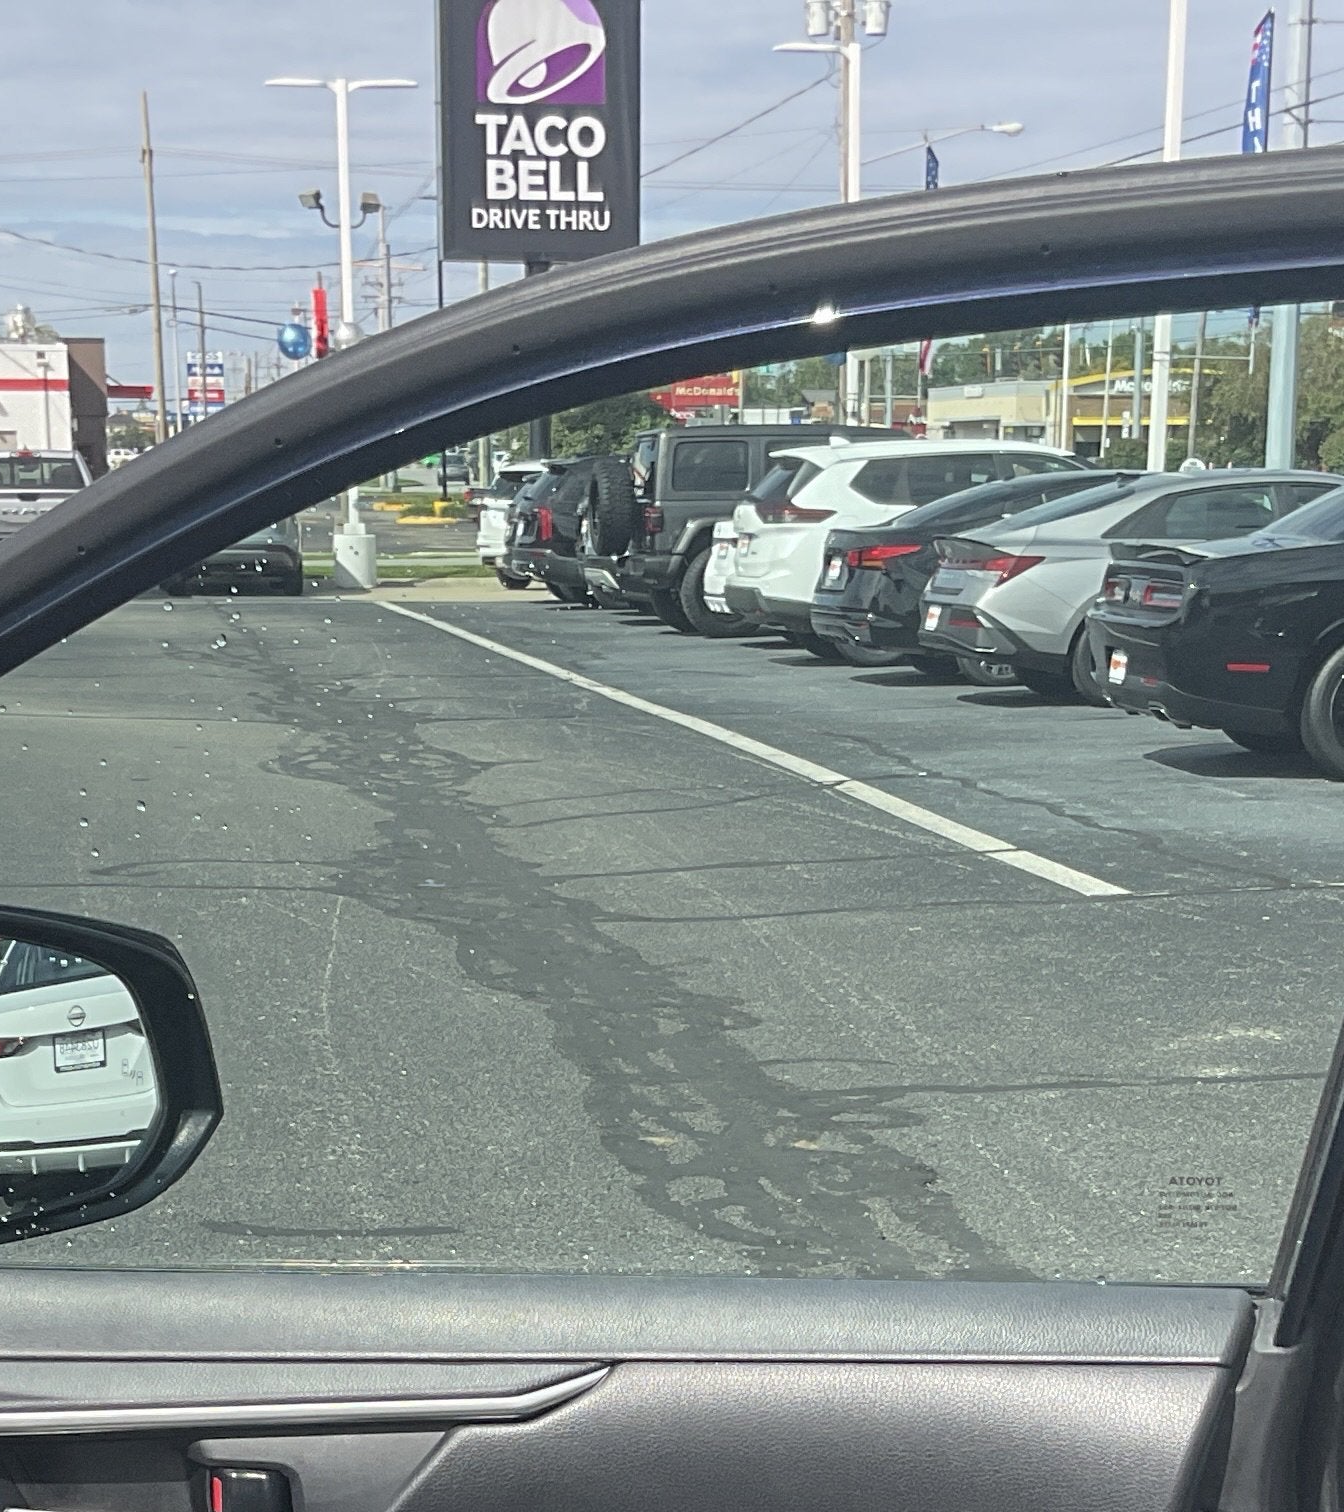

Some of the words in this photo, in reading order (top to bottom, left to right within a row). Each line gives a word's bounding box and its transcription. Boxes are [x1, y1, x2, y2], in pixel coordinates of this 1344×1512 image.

[475, 113, 605, 158] TACO
[486, 158, 604, 202] BELL
[471, 207, 541, 230] DRIVE
[545, 209, 611, 231] THRU
